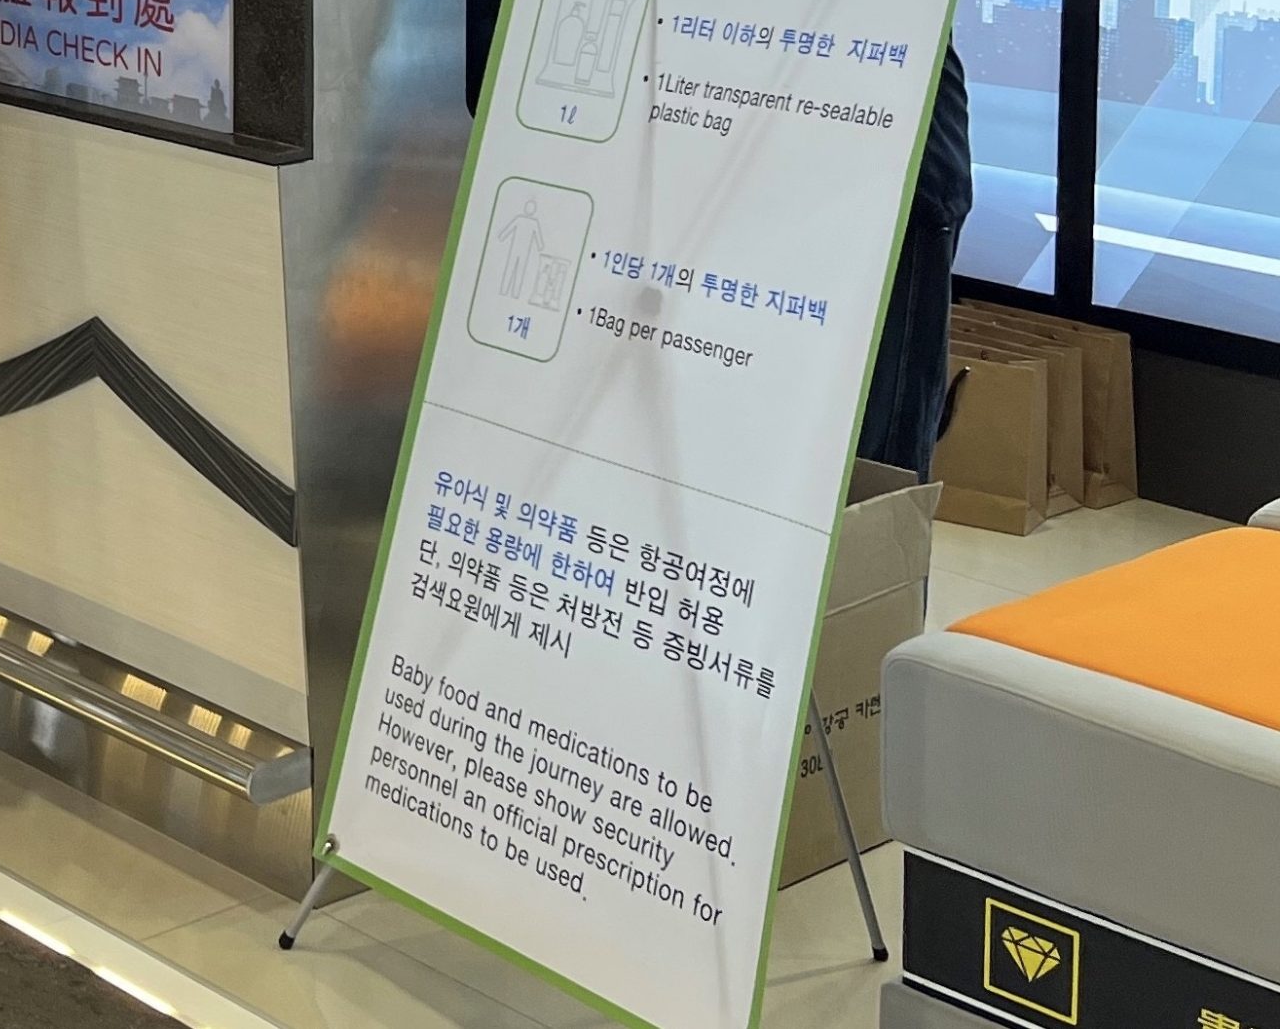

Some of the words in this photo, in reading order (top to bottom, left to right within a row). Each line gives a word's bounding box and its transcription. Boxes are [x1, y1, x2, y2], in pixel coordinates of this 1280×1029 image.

[46, 29, 128, 71] CHECK
[137, 45, 163, 77] IN
[672, 15, 717, 42] 1리터
[722, 21, 775, 50] 이하의
[779, 28, 836, 58] 투명한
[847, 37, 909, 69] 지퍼백
[648, 103, 700, 128] plastic
[702, 109, 733, 137] bag
[657, 72, 701, 97] 1Liter
[703, 80, 792, 113] transparent
[795, 98, 894, 129] re-sealable
[506, 312, 531, 340] 1개
[588, 306, 626, 337] 1Bag
[628, 320, 658, 342] per
[660, 329, 754, 368] passenger
[603, 250, 645, 280] 1인당
[650, 261, 695, 293] 1개의
[700, 272, 759, 309] 투명한
[765, 289, 828, 327] 지퍼백
[427, 503, 480, 546] 필요한
[485, 527, 543, 571] 용량에
[551, 551, 615, 598] 한하여
[625, 578, 668, 617] 반입
[678, 597, 724, 636] 허용
[434, 471, 489, 512] 유아식
[493, 492, 512, 520] 및
[516, 502, 578, 544] 의약품
[586, 525, 630, 563] 등은
[640, 543, 755, 609] 항공여정에
[411, 571, 522, 639] 검색요원에게
[528, 621, 572, 659] 제시
[419, 539, 440, 569] 단,
[448, 551, 502, 593] 의약품
[508, 573, 550, 611] 등은
[556, 593, 623, 640] 처방전
[632, 620, 654, 650] 등
[663, 631, 775, 700] 증빙서류를
[384, 687, 425, 719] used
[429, 707, 487, 752] during
[494, 733, 524, 764] the
[528, 748, 604, 803] journey
[609, 790, 643, 817] are
[649, 807, 736, 867] allowed.
[391, 654, 434, 695] Baby
[438, 676, 480, 711] food
[485, 701, 523, 730] and
[527, 719, 650, 786] medications
[657, 771, 678, 798] to
[685, 782, 713, 813] be
[364, 774, 474, 840] medications
[480, 825, 498, 852] to
[505, 836, 529, 867] be
[536, 856, 587, 902] used.
[370, 745, 459, 799] personnel
[463, 789, 487, 814] an
[493, 803, 558, 847] official
[562, 835, 685, 910] prescription
[692, 892, 723, 926] for
[378, 711, 457, 772] However,
[464, 756, 528, 799] please
[534, 788, 587, 826] show
[592, 816, 675, 872] security
